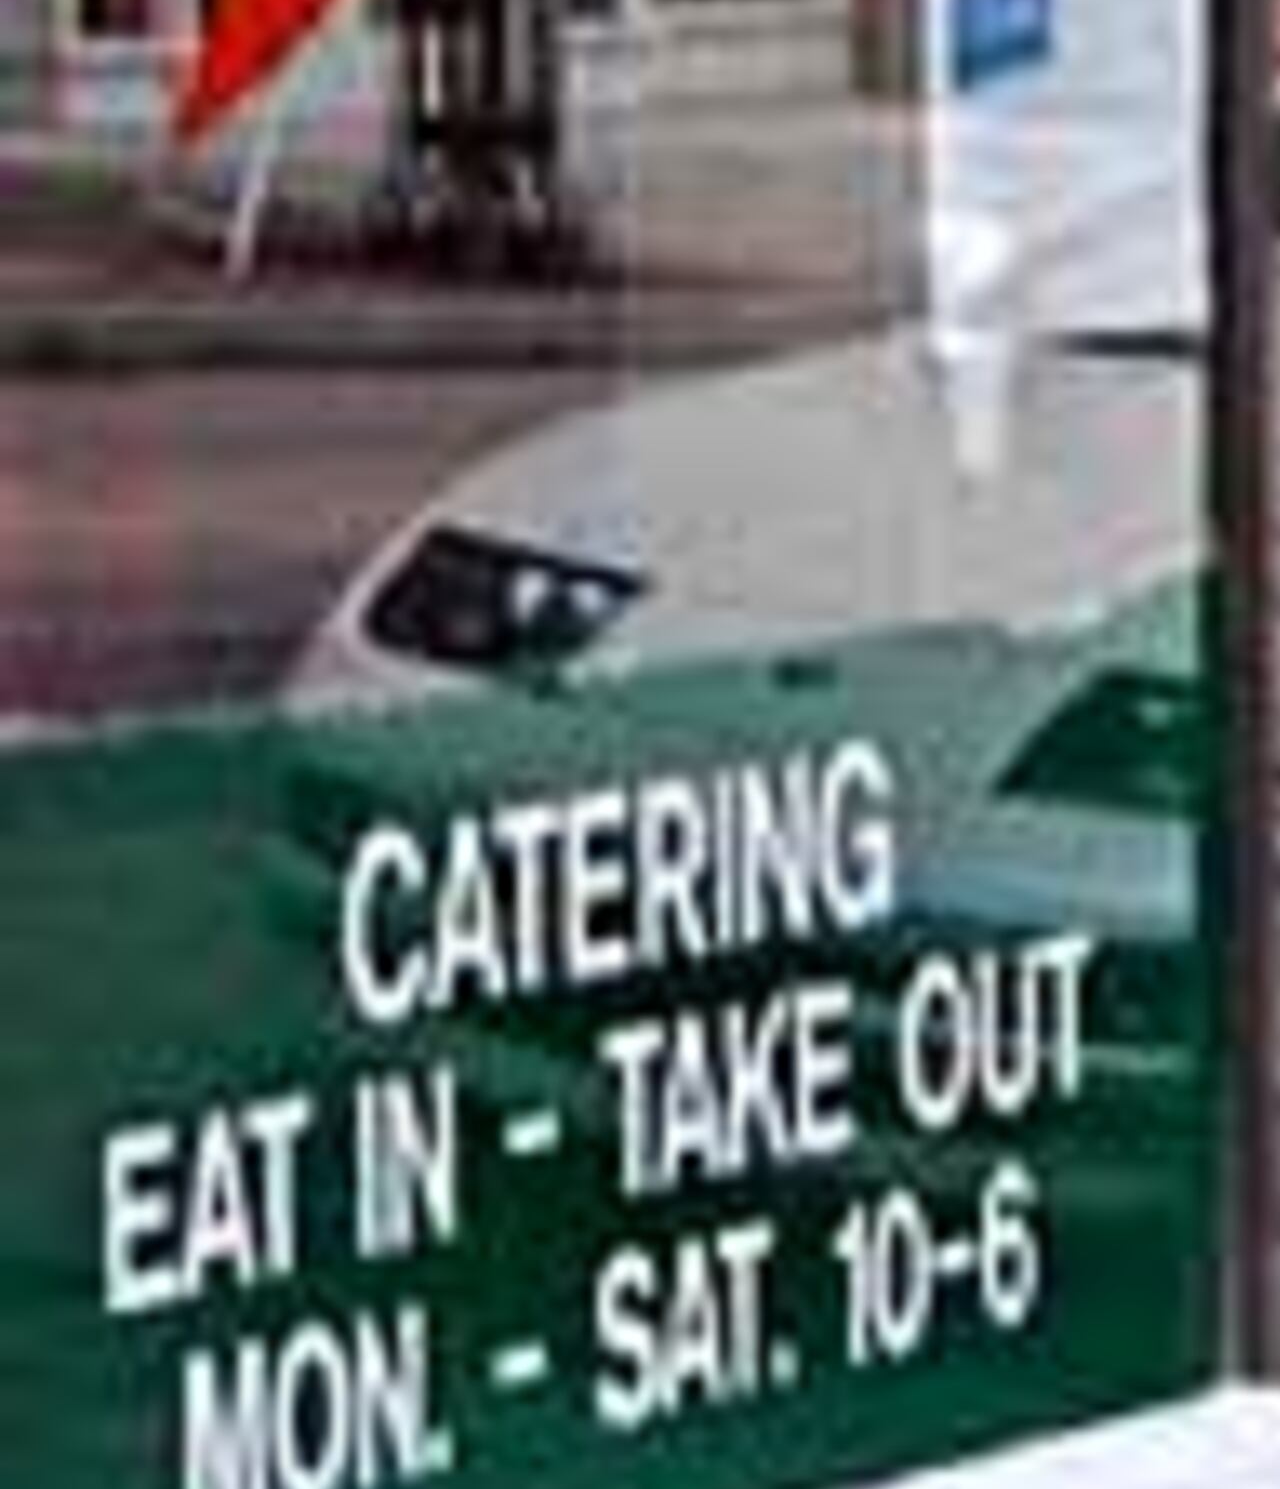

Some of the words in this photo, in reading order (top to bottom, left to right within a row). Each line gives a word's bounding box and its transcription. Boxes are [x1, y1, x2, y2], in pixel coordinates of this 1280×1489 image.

[343, 740, 895, 1020] CATERING
[105, 1095, 310, 1312] EAT
[355, 1067, 455, 1258] IN
[603, 982, 853, 1194] TAKE
[899, 935, 1092, 1128] OUT
[596, 1222, 797, 1430] SAT.
[836, 1162, 1038, 1365] 10-6
